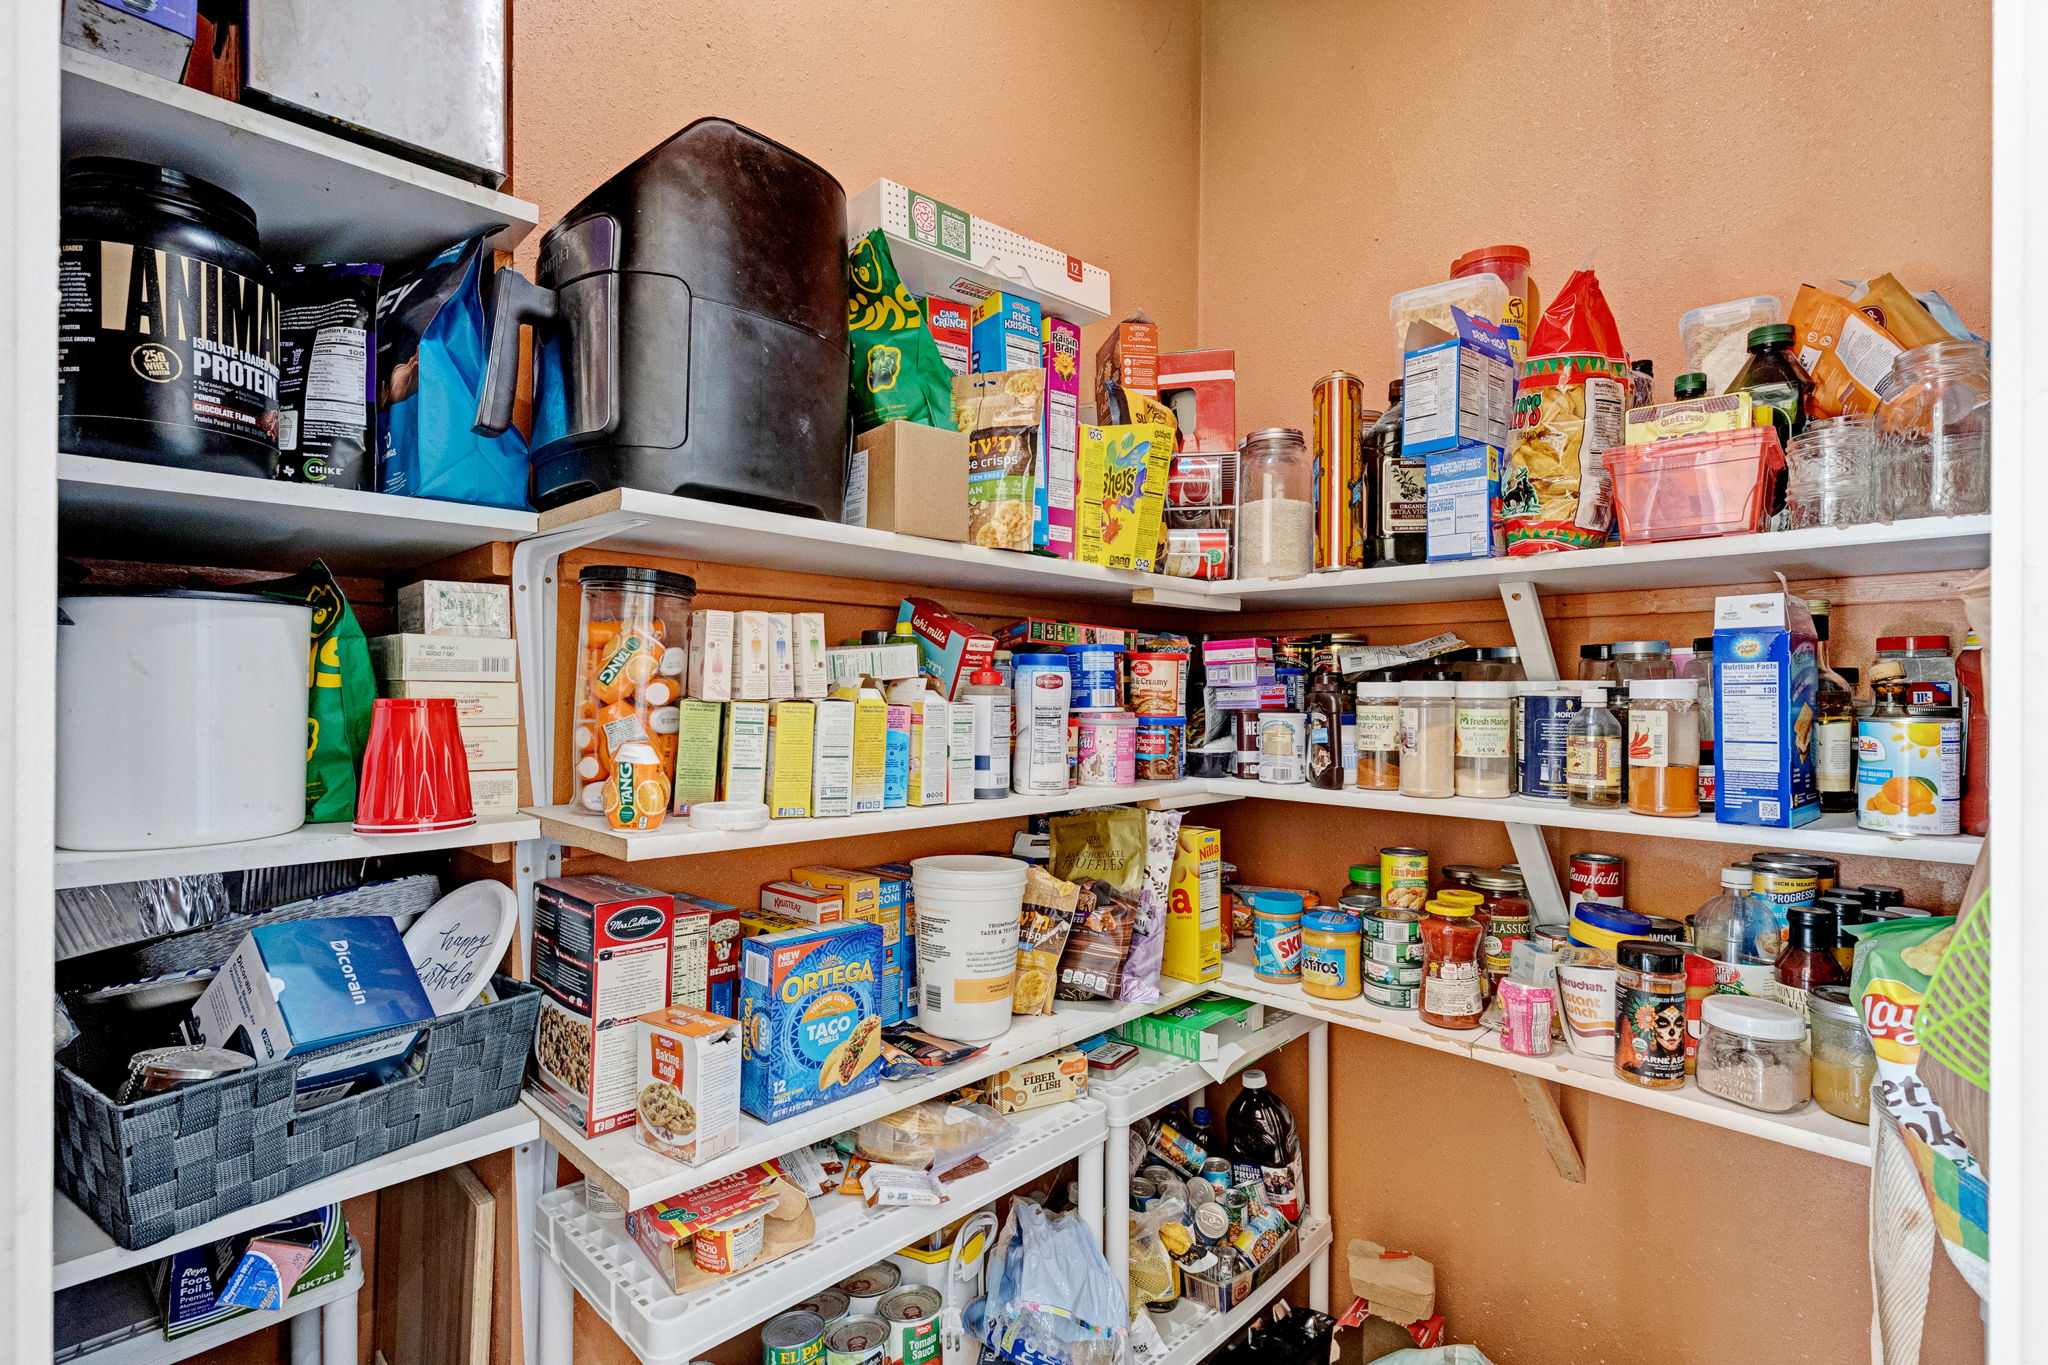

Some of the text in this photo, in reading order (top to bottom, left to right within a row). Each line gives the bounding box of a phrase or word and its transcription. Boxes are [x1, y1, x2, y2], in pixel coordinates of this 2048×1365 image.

[1069, 262, 1079, 274] 12
[932, 316, 967, 330] CRUNCH
[1012, 311, 1032, 325] RICE
[317, 328, 366, 337] Nutrition Facts
[1004, 319, 1040, 337] KRISPIES
[1052, 332, 1078, 349] Raisin
[193, 336, 238, 360] ISOLATE
[348, 349, 365, 357] 100
[1055, 343, 1076, 357] Bran
[142, 350, 166, 363] 25G
[143, 361, 170, 372] WHEY
[193, 350, 278, 401] PROTEIN
[193, 392, 221, 405] POWDER
[194, 403, 256, 425] CHOCOLATE FLAVOR
[194, 414, 231, 428] Protein Powder
[980, 454, 1018, 468] crisps
[309, 465, 342, 475] CHIKE
[984, 472, 1000, 480] FREE
[926, 625, 946, 644] mills
[598, 649, 632, 687] TANG
[1140, 678, 1168, 687] Creamy
[1763, 686, 1777, 694] 130
[1371, 714, 1394, 723] Market
[757, 726, 764, 734] 10
[1136, 736, 1165, 744] Chocolate
[1859, 739, 1878, 750] Dole
[1136, 743, 1153, 754] Fudge
[619, 761, 634, 806] TANG
[1082, 850, 1125, 858] CHOCOLATE
[1199, 844, 1220, 860] Nilla
[1062, 858, 1126, 871] TRUFFLES
[1391, 867, 1405, 877] Las
[1569, 868, 1619, 887] Campbell's
[879, 884, 900, 894] PASTA
[879, 895, 900, 905] RONI
[1770, 889, 1816, 904] PROGRESSO
[774, 896, 802, 913] KRUSTEAZ
[675, 916, 696, 924] Nutrition
[439, 922, 494, 959] happy
[642, 944, 664, 953] Directions
[778, 950, 800, 962] NEW
[710, 965, 737, 976] HELPER
[777, 959, 795, 968] LOOK
[236, 954, 253, 995] Dicorain
[329, 939, 367, 1006] Dicorain
[231, 962, 244, 989] Electric
[241, 990, 251, 1014] Mason
[781, 959, 875, 1004] ORTEGA
[228, 967, 248, 1018] Vacuum Sealer
[1719, 985, 1740, 995] CIDER
[810, 993, 849, 1014] YELLOW CORN
[1862, 994, 1928, 1046] Lay
[742, 997, 754, 1061] ORTEGA
[759, 1016, 767, 1052] TACO
[806, 1015, 851, 1041] TACO
[817, 1034, 839, 1046] SHELLS
[655, 1048, 680, 1067] Baking
[1636, 1054, 1670, 1065] CARNE
[659, 1063, 676, 1078] Soda
[1022, 1071, 1056, 1086] FIBER
[773, 1080, 787, 1095] 12
[1031, 1079, 1062, 1093] d'LISH
[773, 1096, 791, 1106] SHELLS
[1234, 1169, 1261, 1179] FRUIT
[688, 1180, 749, 1203] CHEESE SAUCE
[695, 1240, 718, 1255] NACHO
[181, 1266, 207, 1278] Reyn
[222, 1272, 244, 1304] Reynolds
[296, 1270, 338, 1294] RK721
[180, 1284, 203, 1297] Foil
[908, 1333, 937, 1351] Tomato
[779, 1349, 800, 1365] EL
[912, 1346, 935, 1361] Sauce
